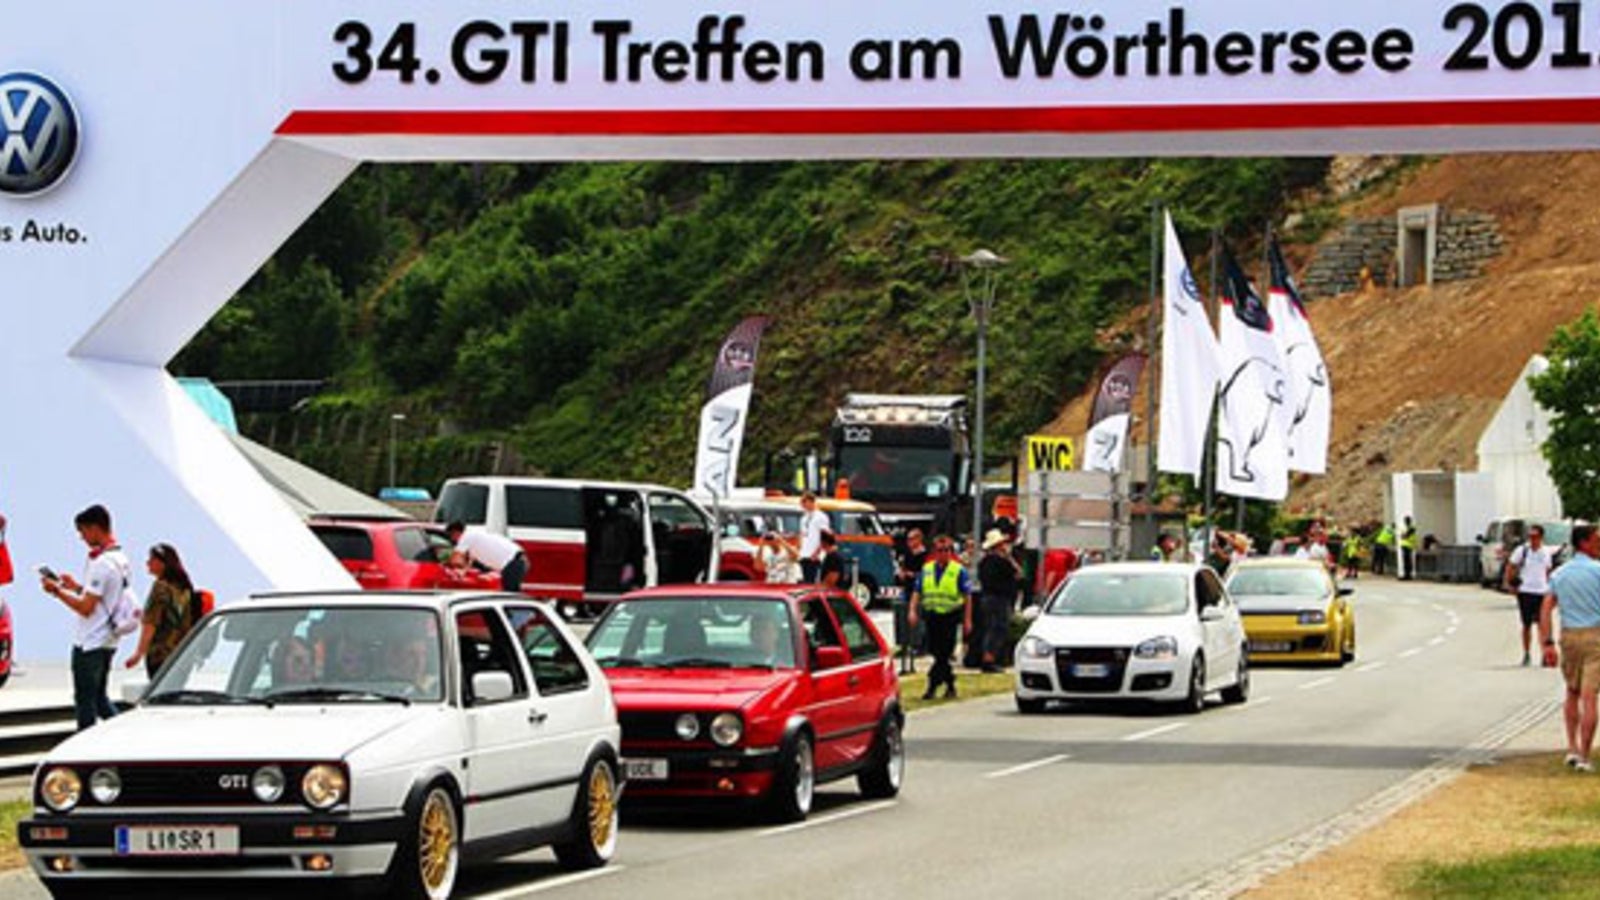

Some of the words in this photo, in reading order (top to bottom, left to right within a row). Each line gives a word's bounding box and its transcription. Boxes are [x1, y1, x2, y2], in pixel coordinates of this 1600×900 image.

[333, 21, 440, 84] 34.
[452, 21, 568, 84] GTI
[593, 16, 823, 82] Treffen
[850, 39, 960, 81] am
[988, 8, 1413, 78] Wörthersee
[1443, 0, 1600, 71] 201
[21, 220, 86, 244] Auto.
[1031, 441, 1071, 471] WC
[219, 774, 248, 789] GTI
